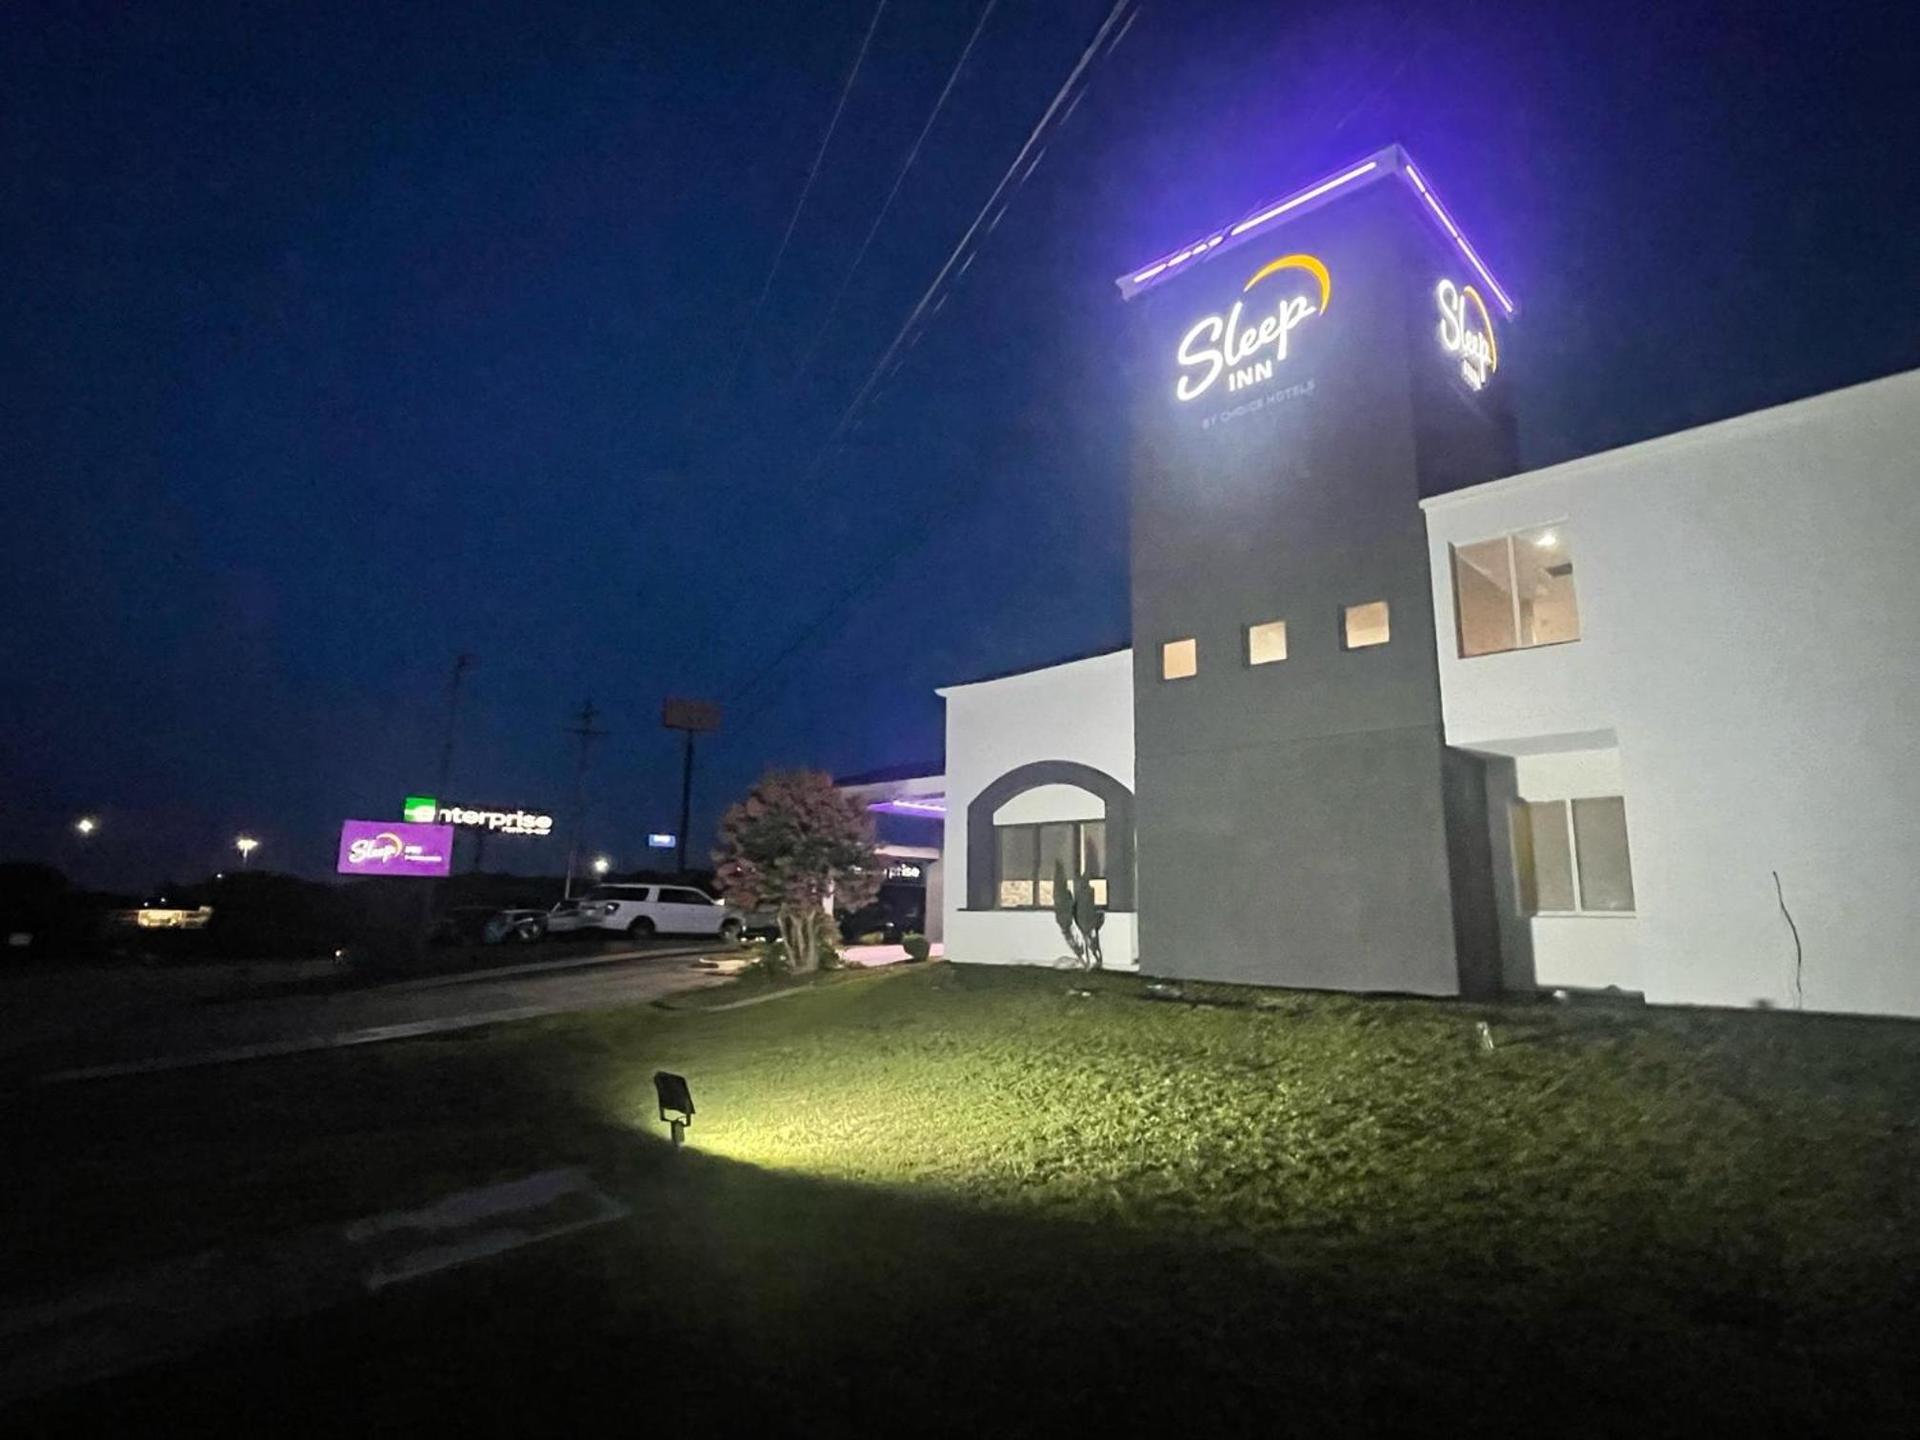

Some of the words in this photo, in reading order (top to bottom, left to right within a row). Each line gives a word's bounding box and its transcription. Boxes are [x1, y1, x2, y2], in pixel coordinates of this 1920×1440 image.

[1176, 295, 1318, 402] Sleep
[1228, 359, 1273, 392] INN
[1437, 278, 1492, 383] Sleep
